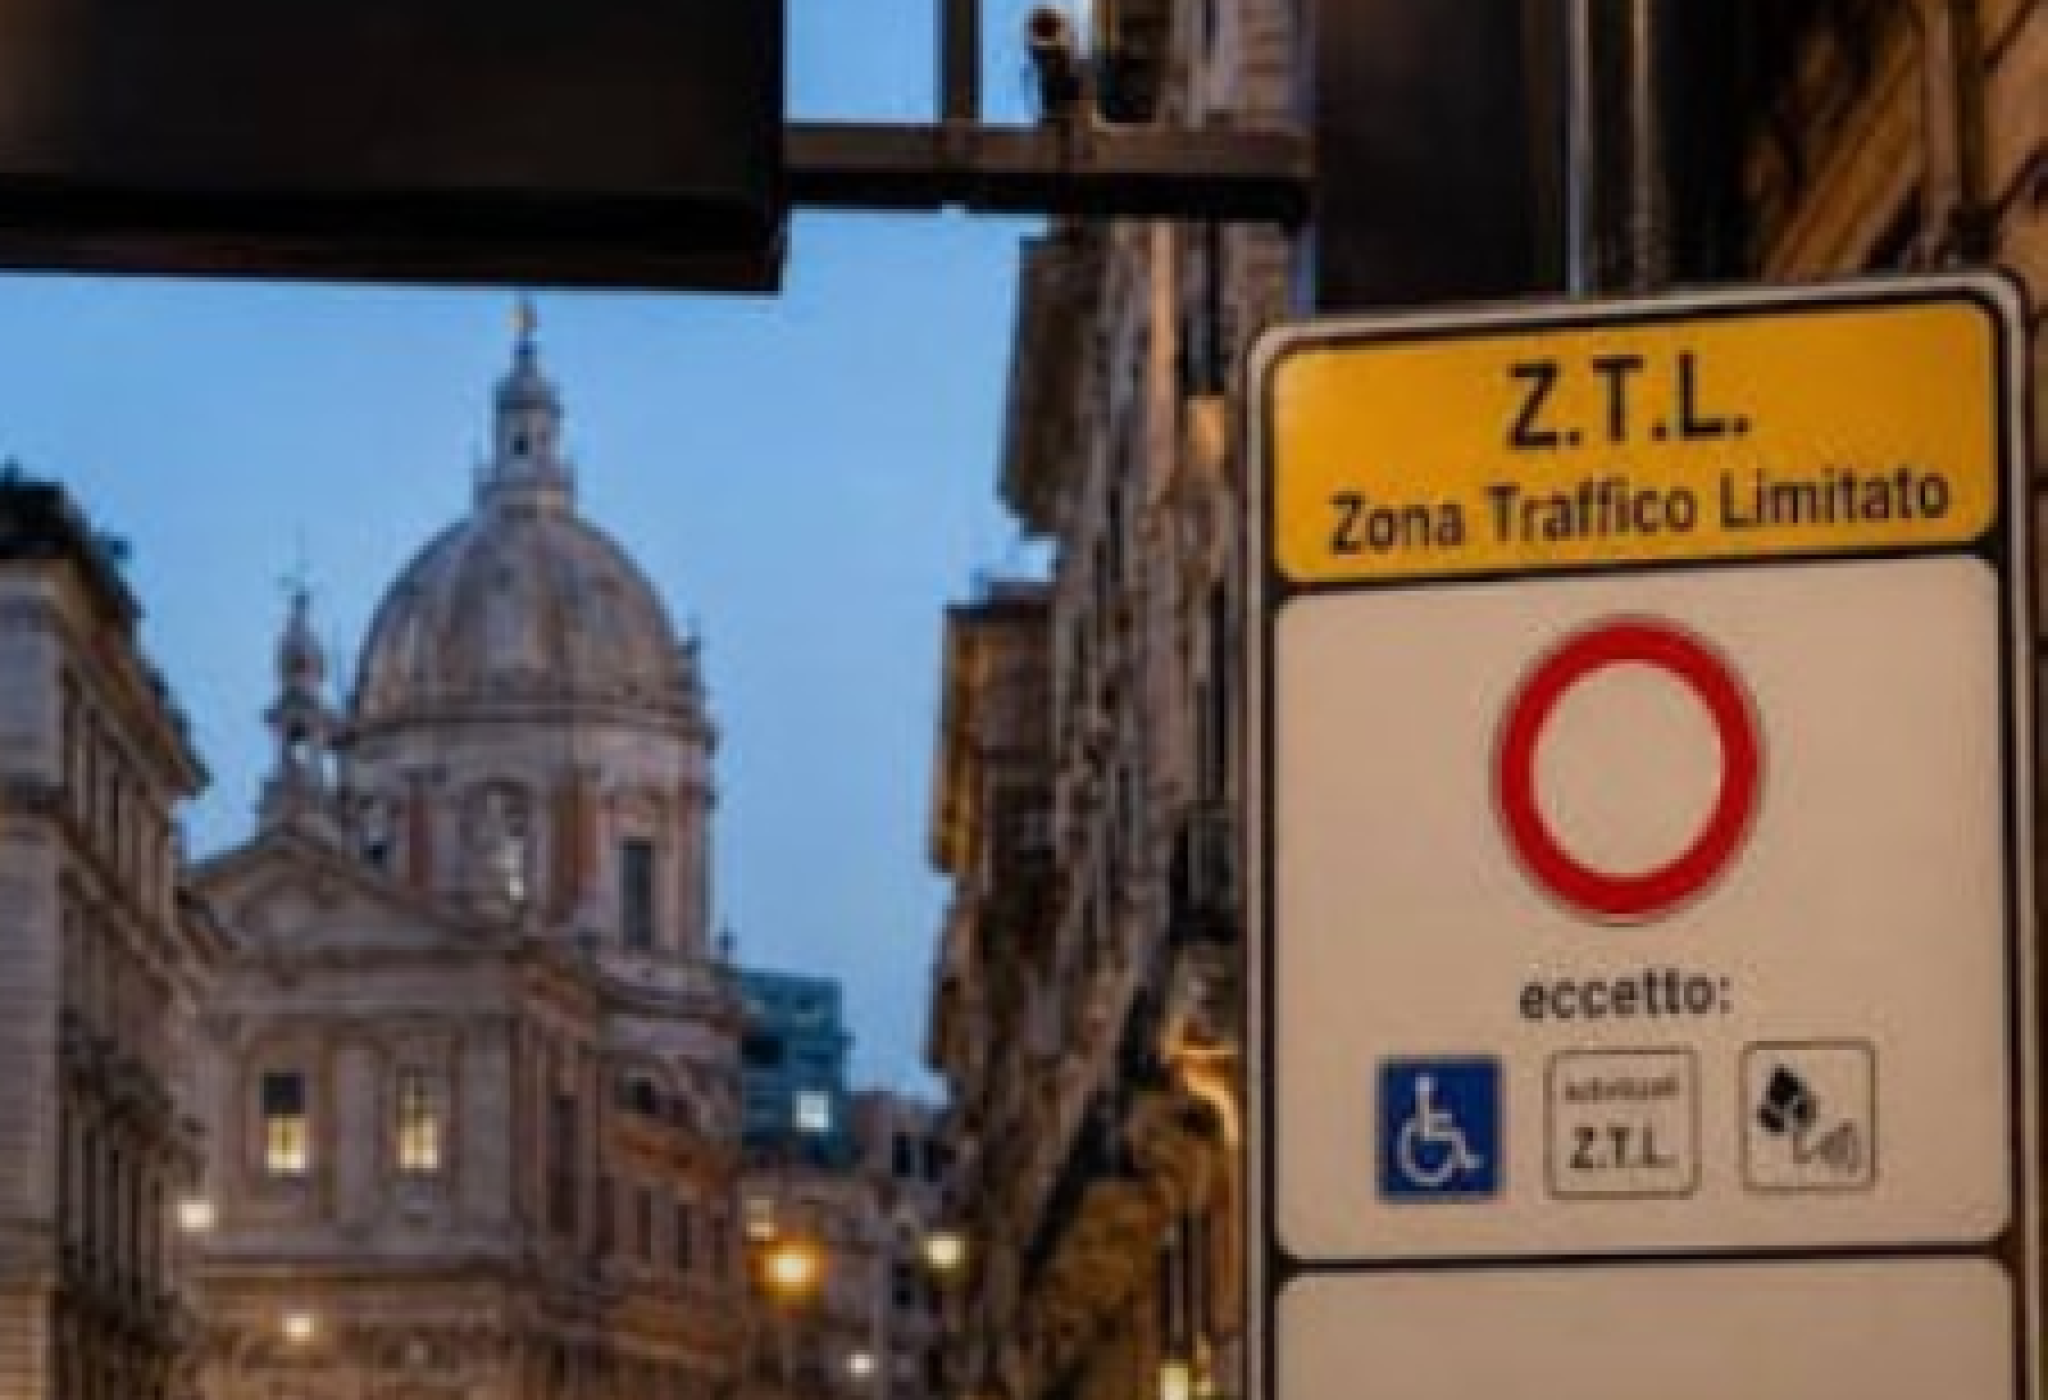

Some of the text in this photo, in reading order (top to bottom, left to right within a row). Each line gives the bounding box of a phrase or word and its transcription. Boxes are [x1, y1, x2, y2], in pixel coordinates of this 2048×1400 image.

[1508, 352, 1750, 450] Z.T.L.
[1329, 464, 1950, 555] Zona Traffico Limitato
[1519, 968, 1731, 1019] eccetto:
